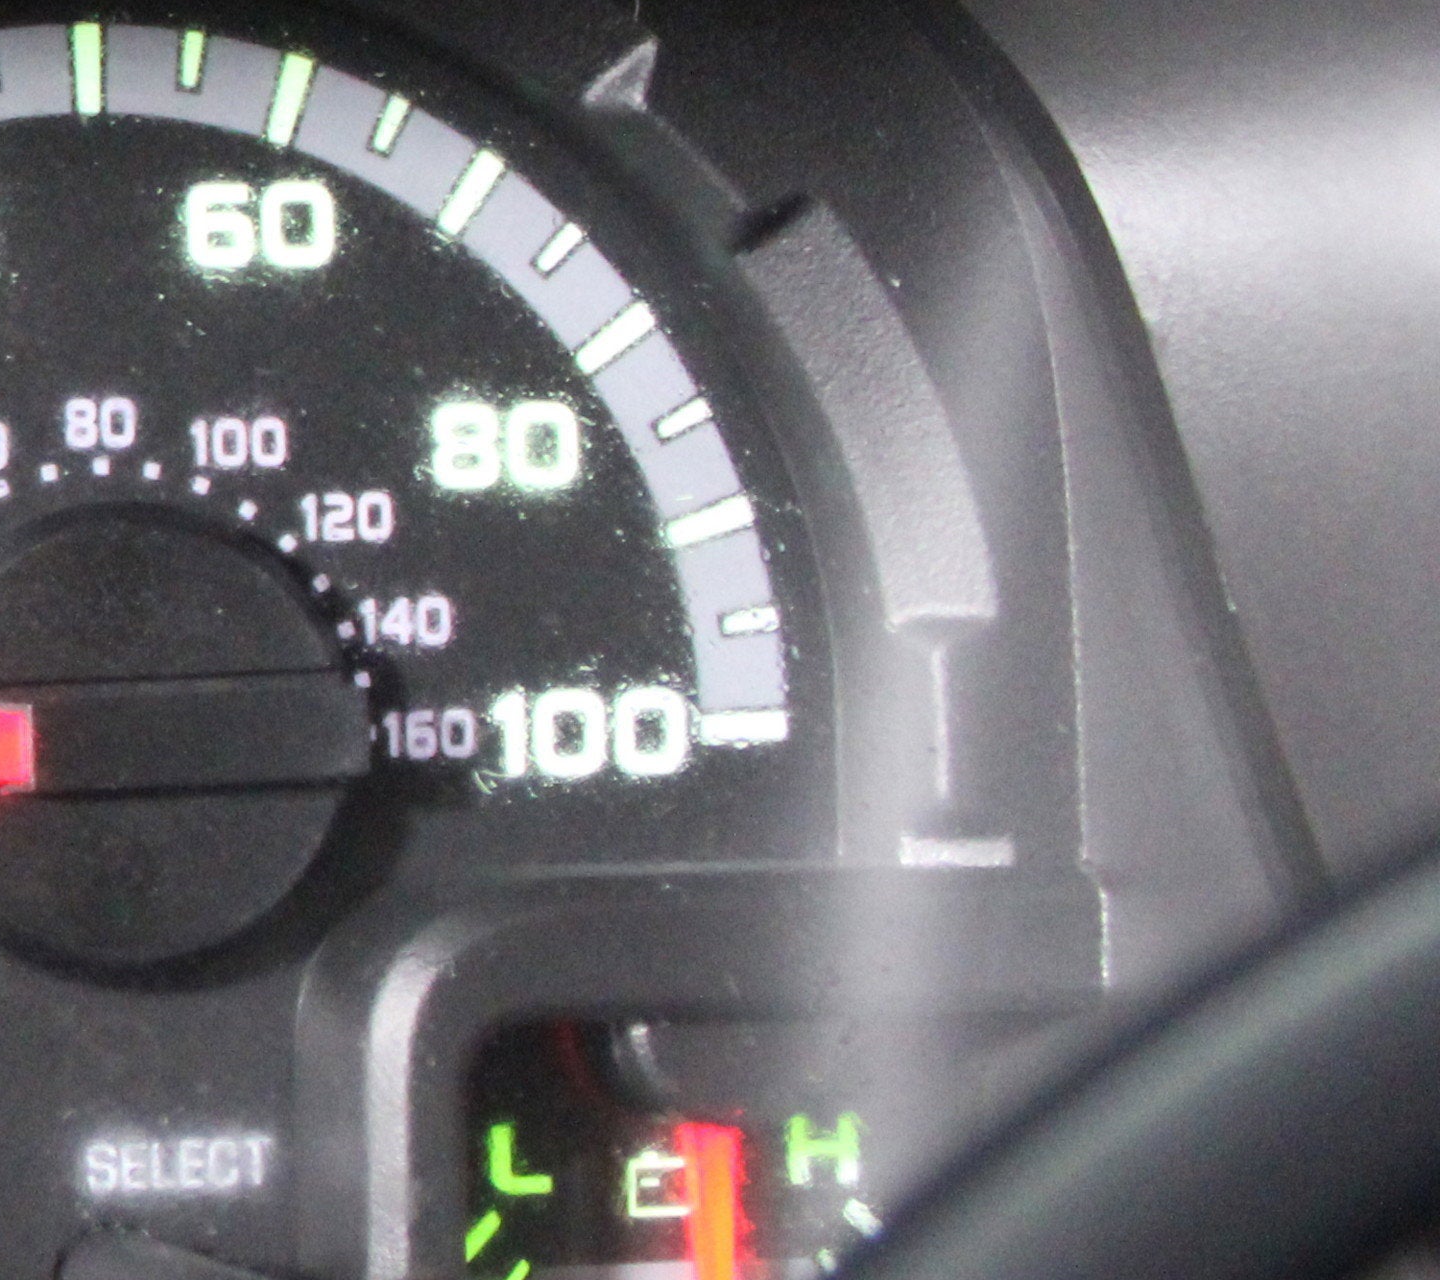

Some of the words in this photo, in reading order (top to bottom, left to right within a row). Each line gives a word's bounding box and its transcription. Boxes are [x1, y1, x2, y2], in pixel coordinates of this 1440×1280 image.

[178, 176, 340, 276] 60
[63, 396, 137, 450] 80
[189, 415, 288, 469] 100
[428, 398, 582, 496] 80
[299, 490, 395, 544] 120
[358, 592, 454, 648] 140
[384, 706, 479, 759] 160
[494, 685, 684, 778] 100
[83, 1134, 272, 1195] SELECT
[487, 1124, 554, 1197] L
[786, 1111, 863, 1188] H
